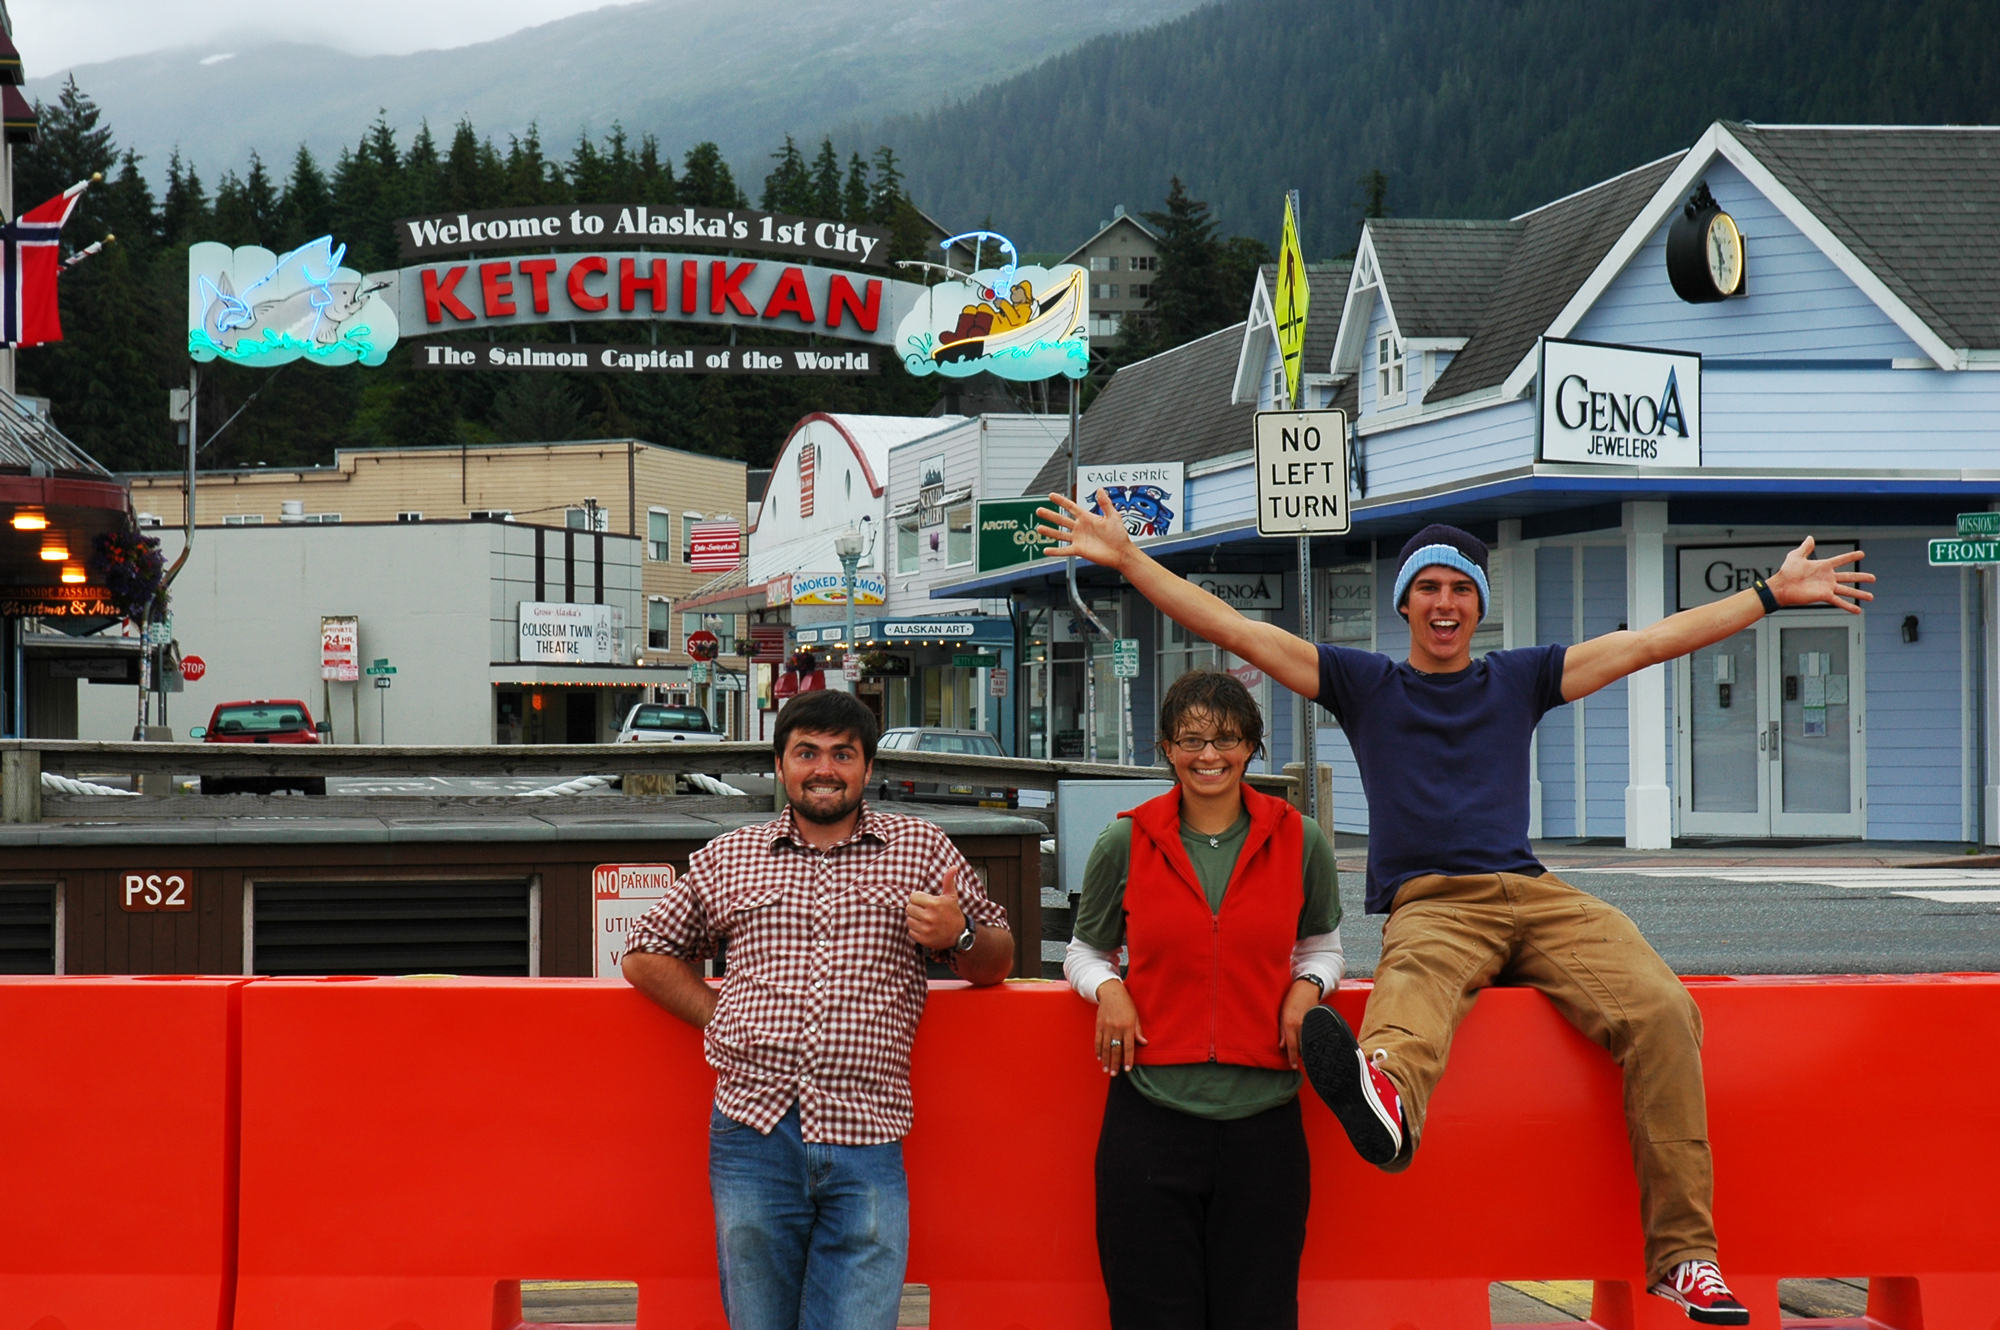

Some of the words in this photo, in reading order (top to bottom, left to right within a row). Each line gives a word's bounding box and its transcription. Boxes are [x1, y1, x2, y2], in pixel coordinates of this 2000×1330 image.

[408, 214, 561, 247] Welcome
[569, 209, 604, 234] to
[613, 208, 748, 240] Alaska's
[758, 217, 806, 245] 1st
[815, 223, 879, 262] City
[420, 256, 883, 332] KETCHIKAN
[425, 346, 476, 365] The
[489, 347, 588, 367] Salmon
[601, 348, 694, 371] Capital
[706, 350, 731, 369] of
[743, 351, 783, 370] the
[794, 352, 869, 371] World
[1281, 427, 1321, 453] NO
[1587, 435, 1658, 459] JEWELERS
[1087, 470, 1128, 482] EAGLE
[1271, 462, 1334, 486] LEFT
[1268, 495, 1338, 519] TURN
[982, 520, 1018, 530] ARCTIC
[1958, 516, 1992, 532] MISSION
[1936, 543, 1998, 560] FRONT
[20, 587, 55, 597] INSIDE
[58, 587, 102, 597] PASSAGE
[793, 576, 837, 595] SMOKED
[841, 576, 885, 595] SLMON
[1, 601, 67, 615] Christmas
[70, 600, 87, 615] &
[522, 622, 567, 638] COLISEUM
[570, 625, 593, 637] TWIN
[893, 625, 942, 633] ALASKAN
[945, 625, 966, 633] ART
[324, 634, 340, 646] 24
[536, 640, 579, 654] THEATRE
[1115, 642, 1120, 651] 2
[181, 663, 204, 673] STOP
[125, 874, 186, 906] PS2
[597, 871, 619, 893] NO
[621, 873, 668, 888] PARKING
